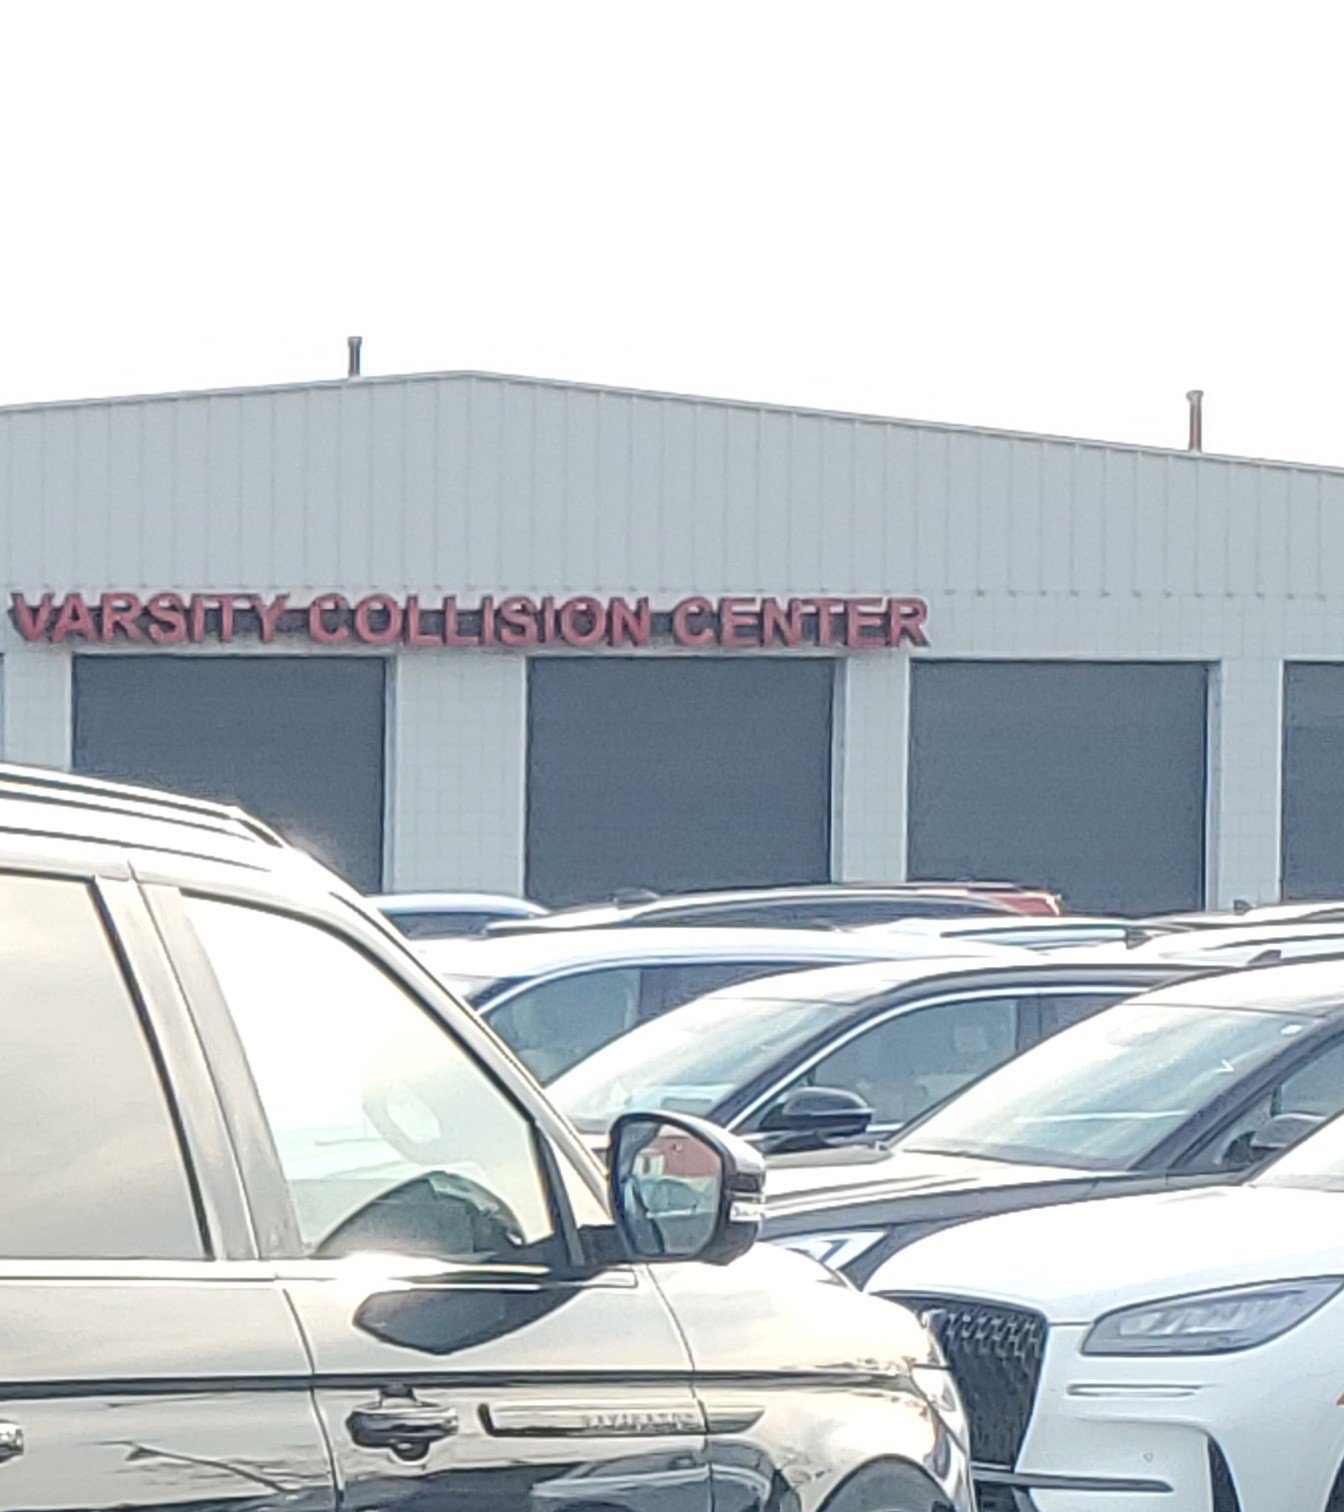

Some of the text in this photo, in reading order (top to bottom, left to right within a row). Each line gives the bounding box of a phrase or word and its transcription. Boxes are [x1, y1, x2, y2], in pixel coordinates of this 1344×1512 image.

[9, 591, 930, 649] VARSITY COLLISION CENTER
